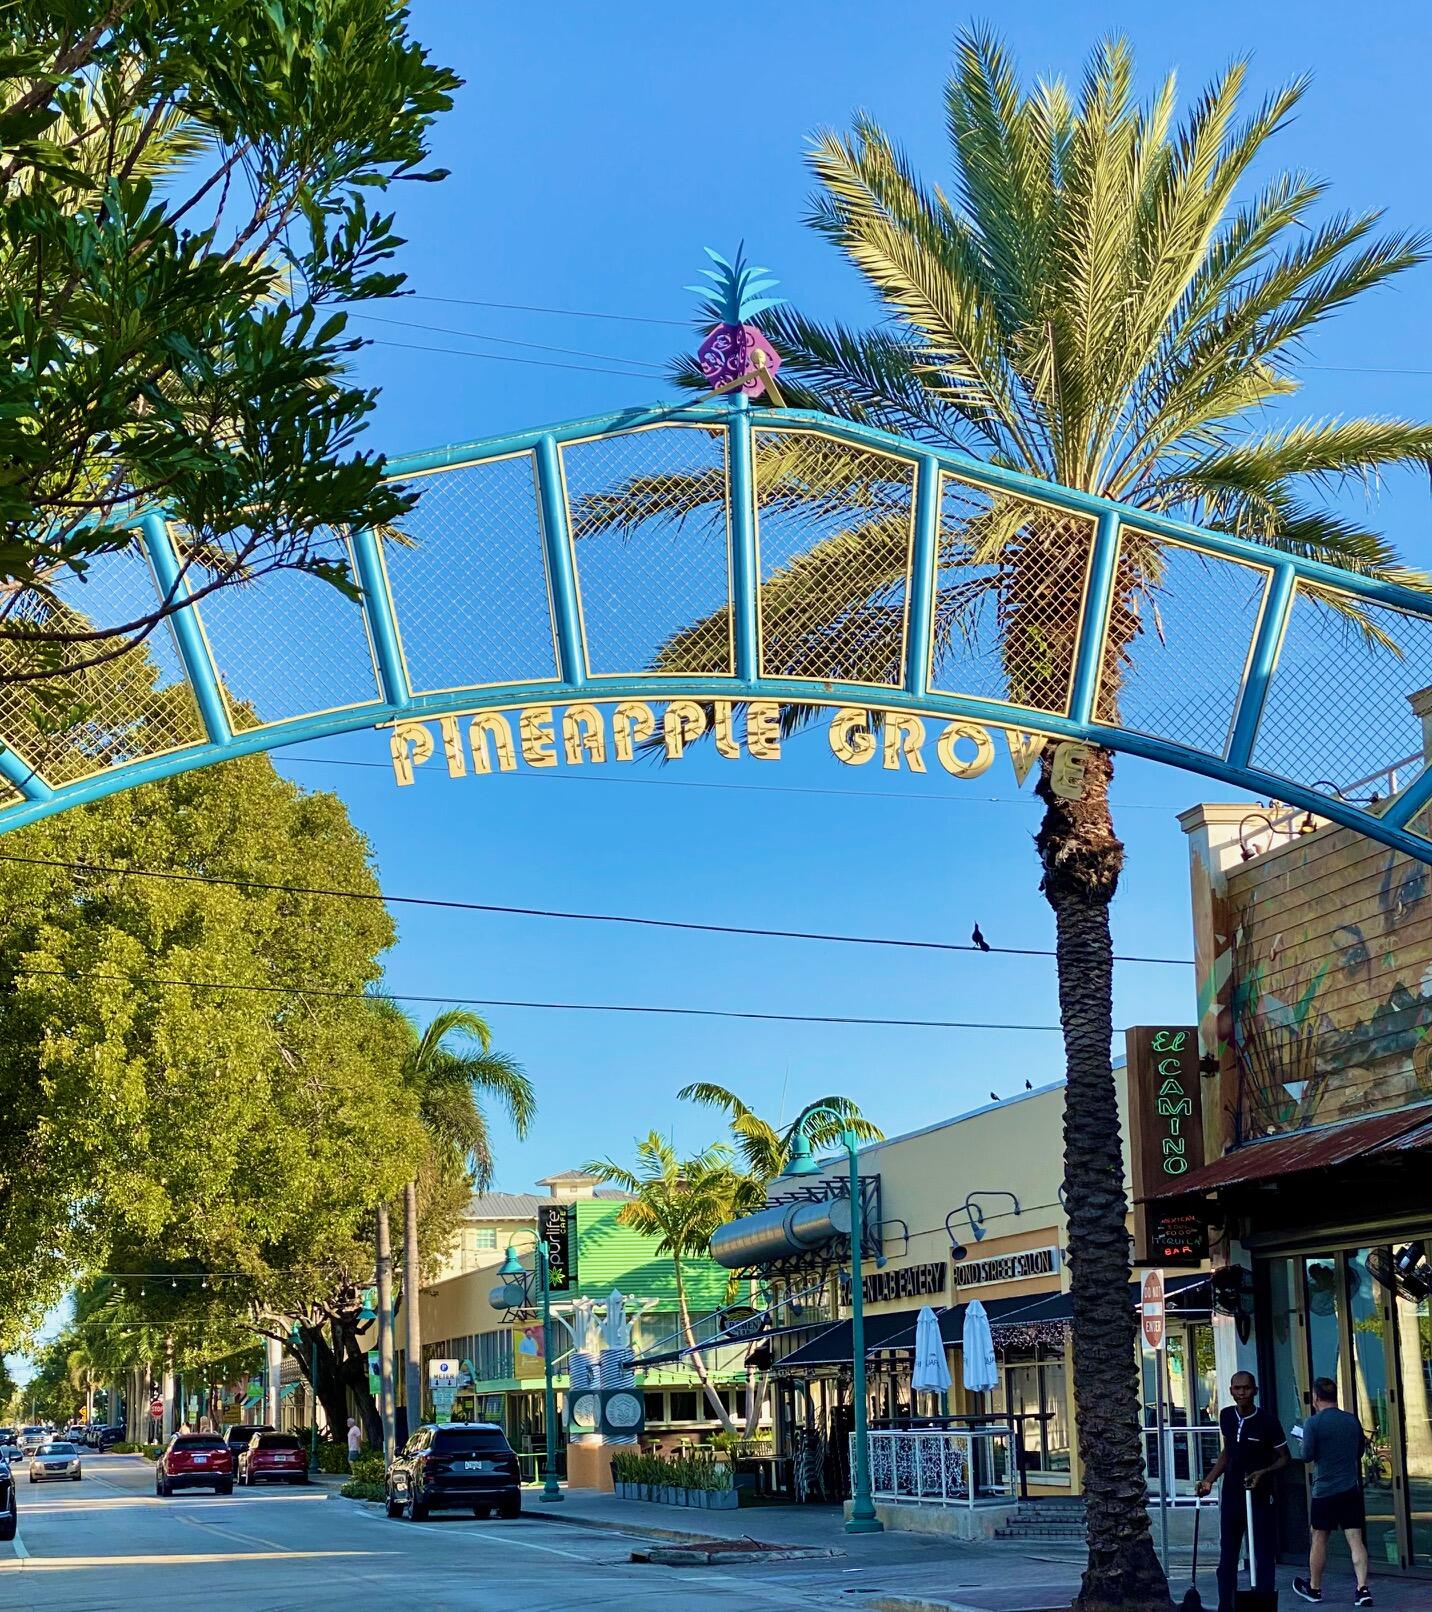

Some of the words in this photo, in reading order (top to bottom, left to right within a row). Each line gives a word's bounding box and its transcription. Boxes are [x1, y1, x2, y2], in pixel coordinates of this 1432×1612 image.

[389, 700, 781, 787] PINEAPPLE
[828, 707, 1091, 802] GROVE
[1151, 1031, 1190, 1052] El
[1158, 1058, 1192, 1175] CAMINO
[546, 1210, 564, 1265] purlife
[1164, 1246, 1192, 1256] BAR
[876, 1271, 897, 1301] LAB
[899, 1262, 942, 1298] EATERY
[954, 1263, 979, 1286] BOND
[1017, 1250, 1052, 1277] SALON
[1144, 1286, 1152, 1298] DO
[1152, 1286, 1161, 1298] NOT
[1145, 1320, 1162, 1333] ENTER
